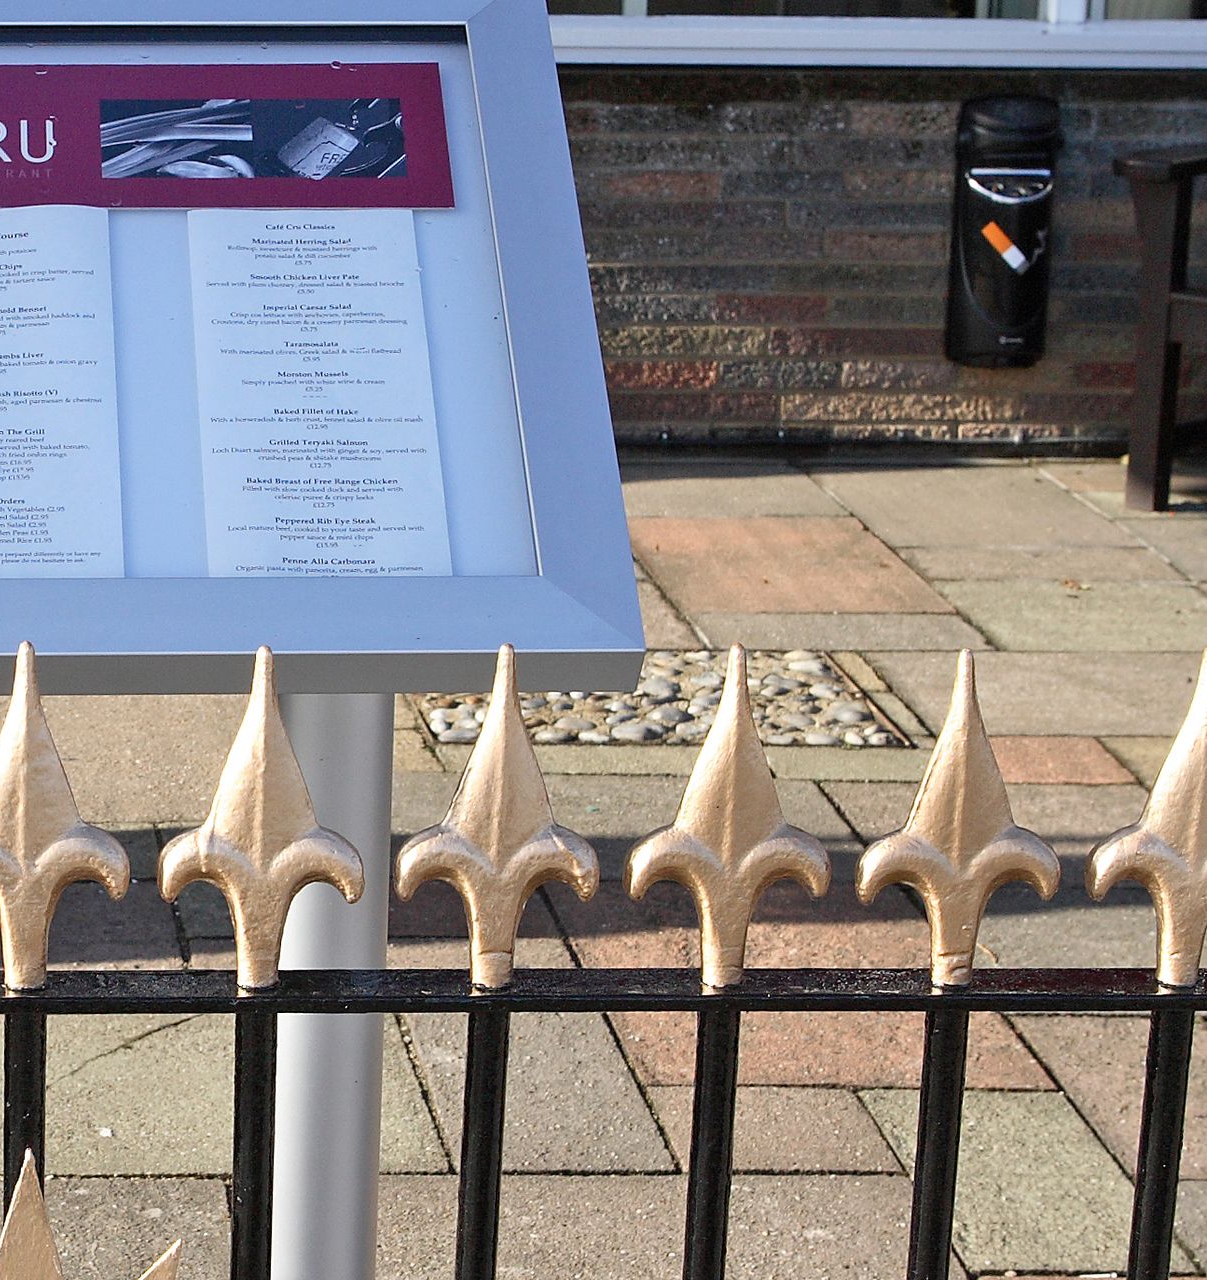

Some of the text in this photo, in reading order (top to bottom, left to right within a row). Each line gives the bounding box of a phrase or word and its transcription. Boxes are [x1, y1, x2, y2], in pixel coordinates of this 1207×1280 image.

[252, 237, 293, 245] Marinated
[295, 237, 327, 246] Herring
[263, 303, 297, 312] Imperial
[22, 351, 44, 359] Liver
[314, 370, 349, 378] Mussels
[44, 388, 58, 398] (V)
[269, 438, 299, 446] Grilled
[335, 438, 369, 446] Salmon
[313, 477, 332, 485] Free
[333, 477, 361, 486] Range
[362, 477, 398, 485] Chicken
[275, 517, 314, 526] Peppered
[334, 517, 350, 526] Eye
[309, 557, 328, 565] Alla
[330, 557, 376, 565] Carbonara
